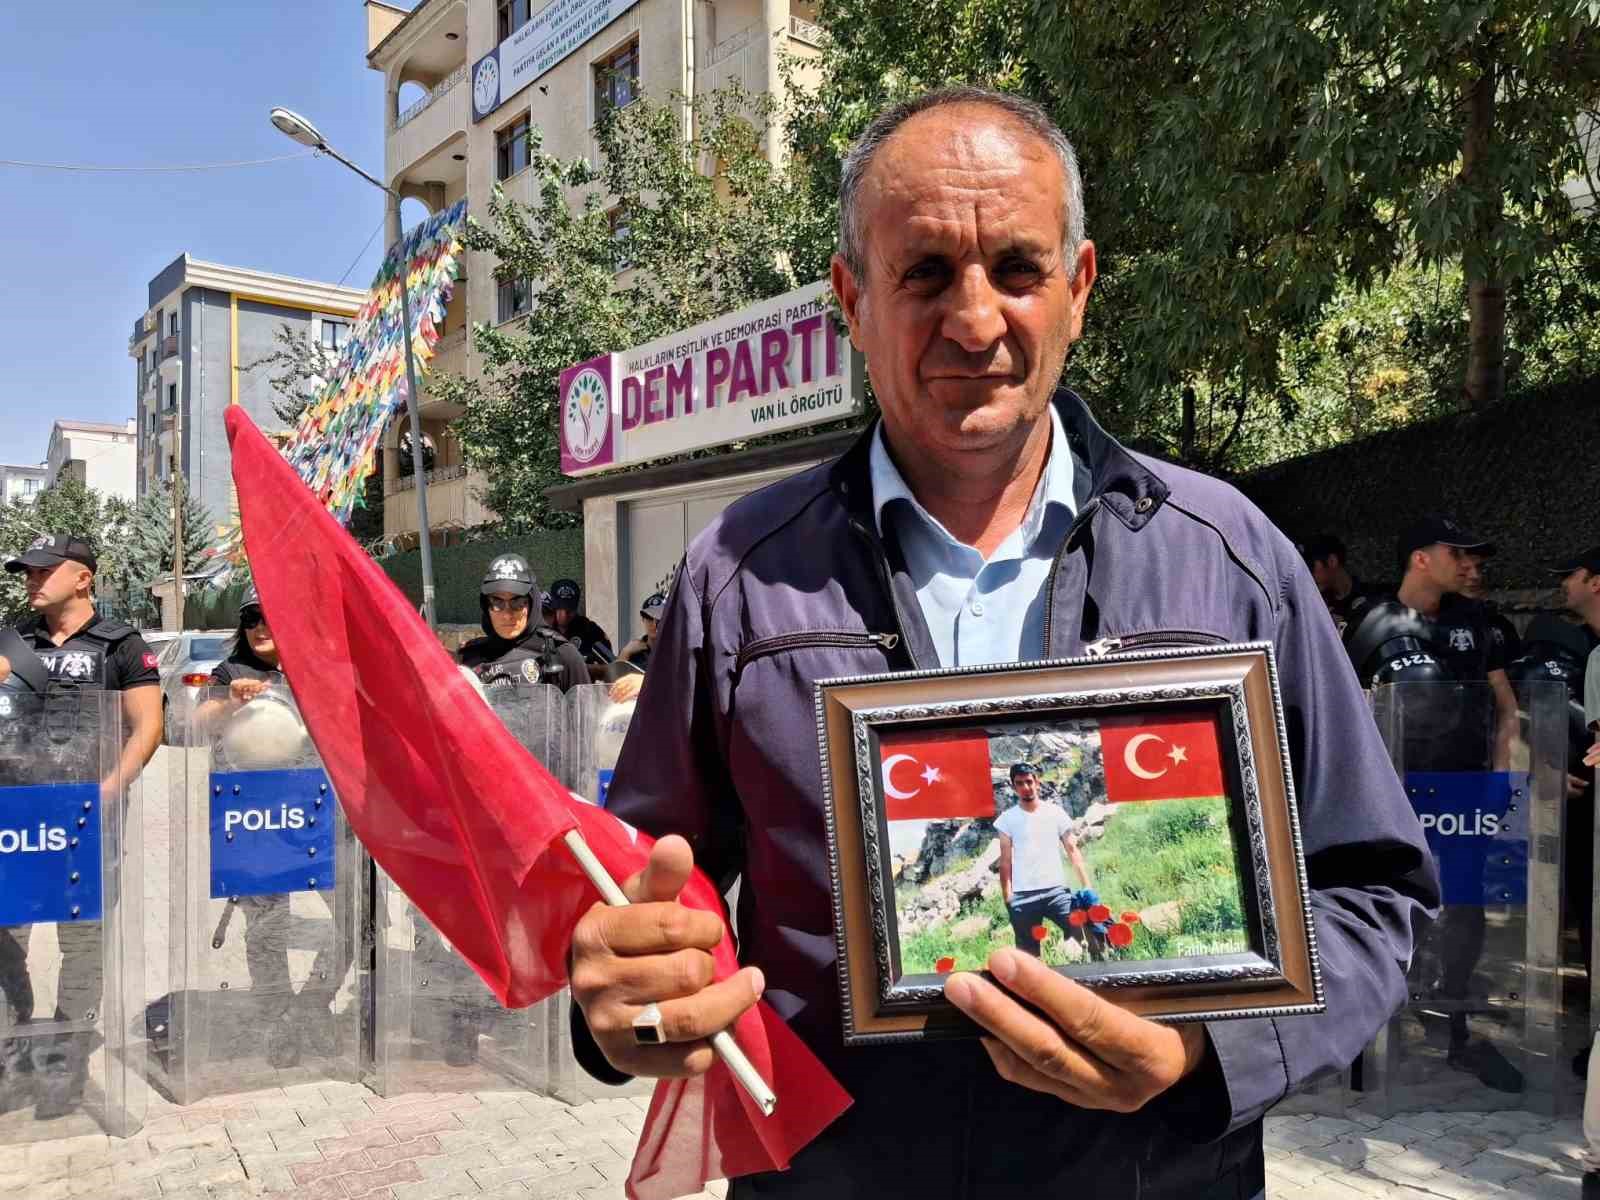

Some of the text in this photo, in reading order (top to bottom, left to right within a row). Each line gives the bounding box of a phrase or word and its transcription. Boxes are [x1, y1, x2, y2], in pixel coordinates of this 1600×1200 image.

[629, 349, 675, 374] HALKLARIN
[676, 336, 709, 360] EŞİTLİK
[711, 331, 723, 348] VE
[724, 311, 782, 344] DEMOKRASİ
[622, 358, 693, 431] DEM
[751, 384, 843, 424] VAN İL ÖRGÜTÜ
[1390, 654, 1436, 671] T213
[225, 803, 304, 832] POLİS
[1419, 808, 1499, 836] POLİS
